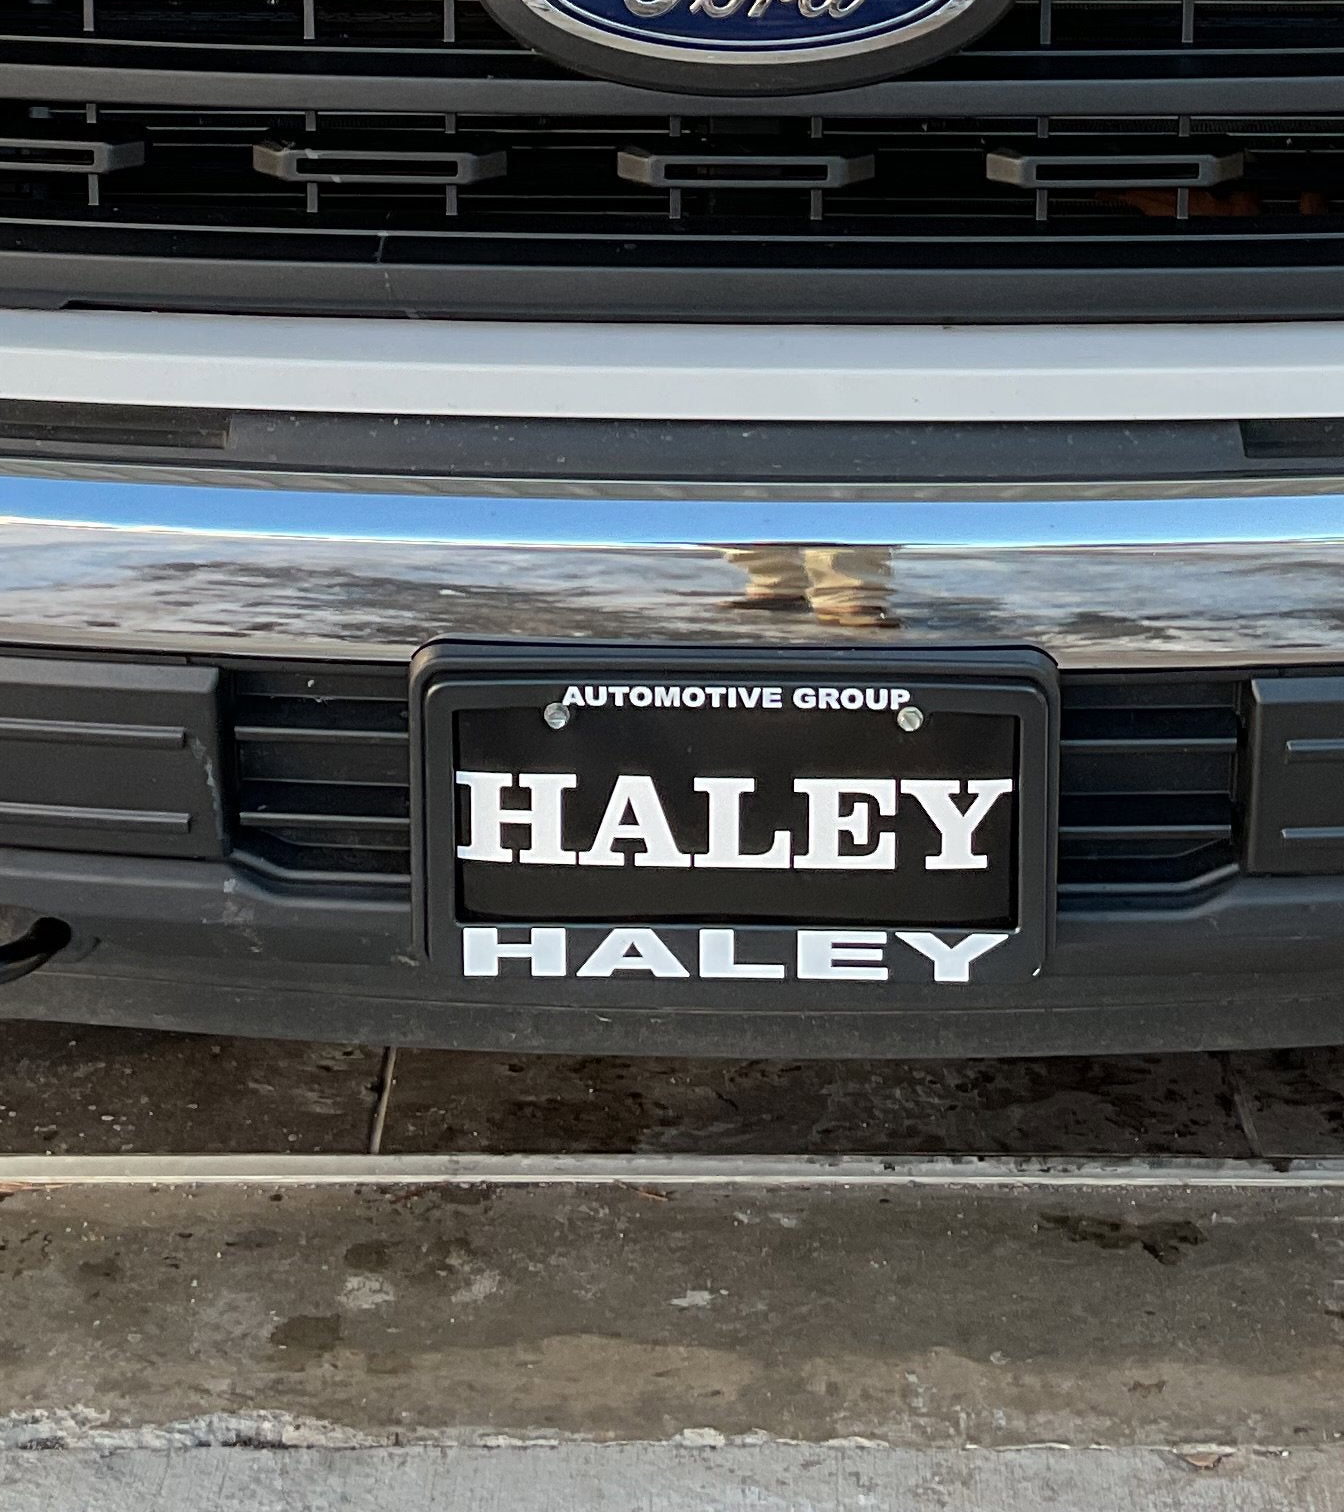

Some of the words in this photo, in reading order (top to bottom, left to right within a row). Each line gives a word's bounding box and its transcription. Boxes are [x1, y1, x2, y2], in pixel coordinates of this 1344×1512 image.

[562, 686, 783, 708] AUTOMOTIVE
[792, 687, 911, 710] GROUP
[457, 771, 1012, 870] HALEY
[463, 927, 1009, 982] HALEY
